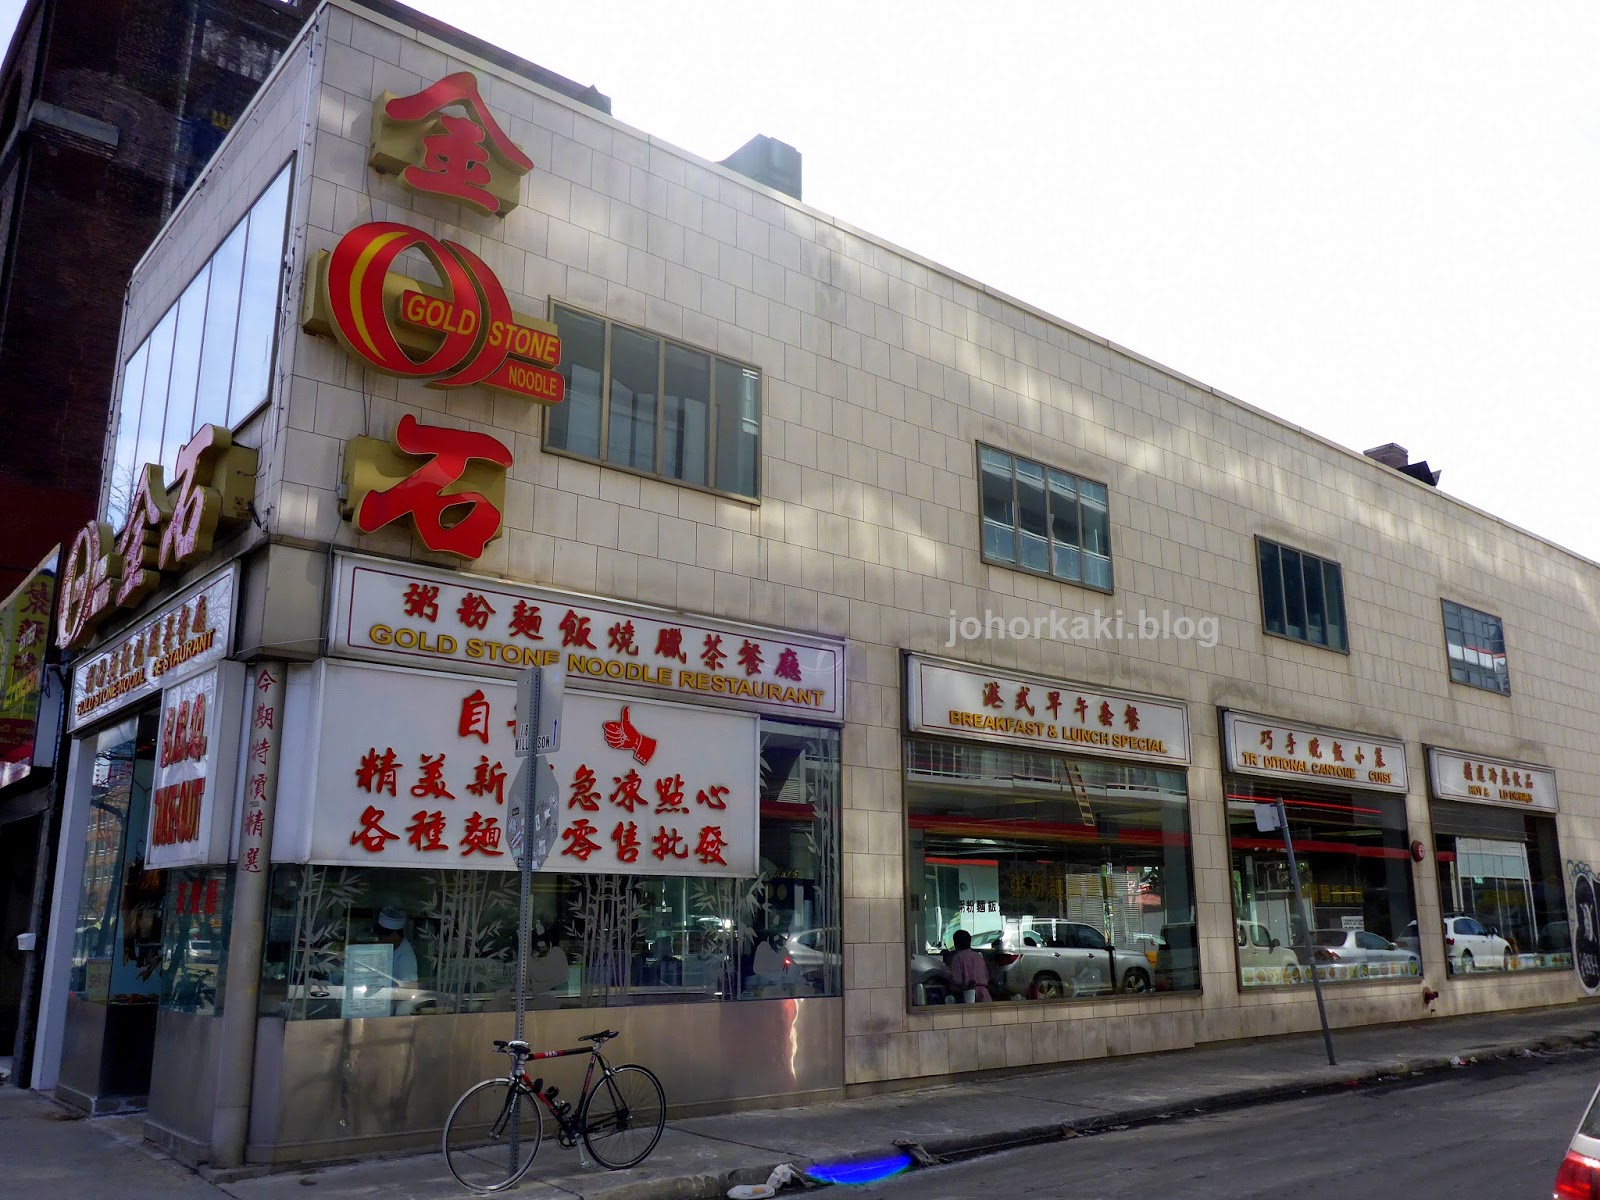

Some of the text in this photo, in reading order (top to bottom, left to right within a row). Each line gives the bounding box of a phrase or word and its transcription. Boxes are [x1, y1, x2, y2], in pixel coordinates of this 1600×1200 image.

[385, 71, 534, 212] 金
[407, 295, 559, 363] GOLD STONE
[508, 366, 558, 397] NOODLE
[359, 413, 513, 560] 石
[369, 624, 825, 707] GOLD STONE NOODLE RESTAURANT
[77, 694, 95, 716] GOLD
[95, 682, 118, 705] STONE
[949, 710, 1168, 753] BREAKFAST & LUNCH SPECIAL
[982, 682, 1141, 732] 港式早午套餐
[241, 669, 277, 873] 今期特價精選
[355, 747, 730, 815] 精美新急凍點心
[1468, 785, 1482, 796] HOT
[351, 805, 729, 867] 各種麵零售批發
